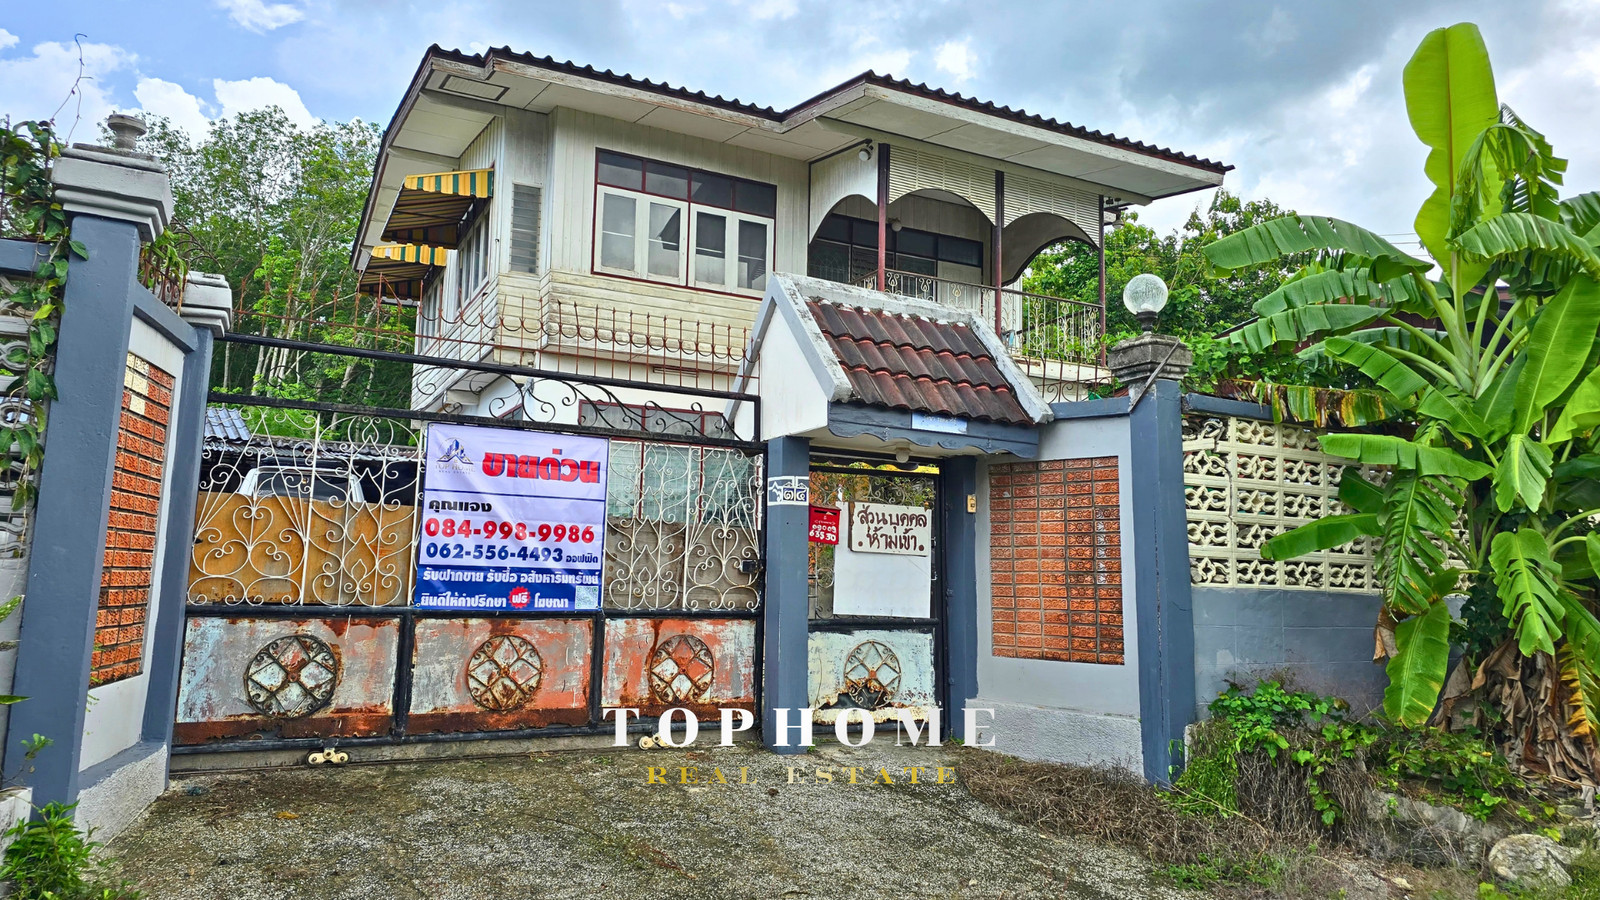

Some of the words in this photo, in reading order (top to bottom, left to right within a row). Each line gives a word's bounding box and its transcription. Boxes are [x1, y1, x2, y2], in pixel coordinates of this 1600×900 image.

[482, 448, 601, 484] ขายด่วน
[428, 499, 493, 513] คุณแจง
[857, 503, 928, 533] ส่วนบุคคล
[424, 518, 595, 544] 084-998-9986
[866, 526, 917, 551] ห้ามเข้า
[426, 542, 564, 563] 062-556-4493
[422, 566, 484, 583] รับฝากขาย
[520, 570, 600, 585] อสังหาริมทรัพย์
[420, 590, 507, 608] ยินดีให้คำปรึกษา
[511, 591, 529, 604] ฟรี
[534, 592, 569, 608] โฆษณา
